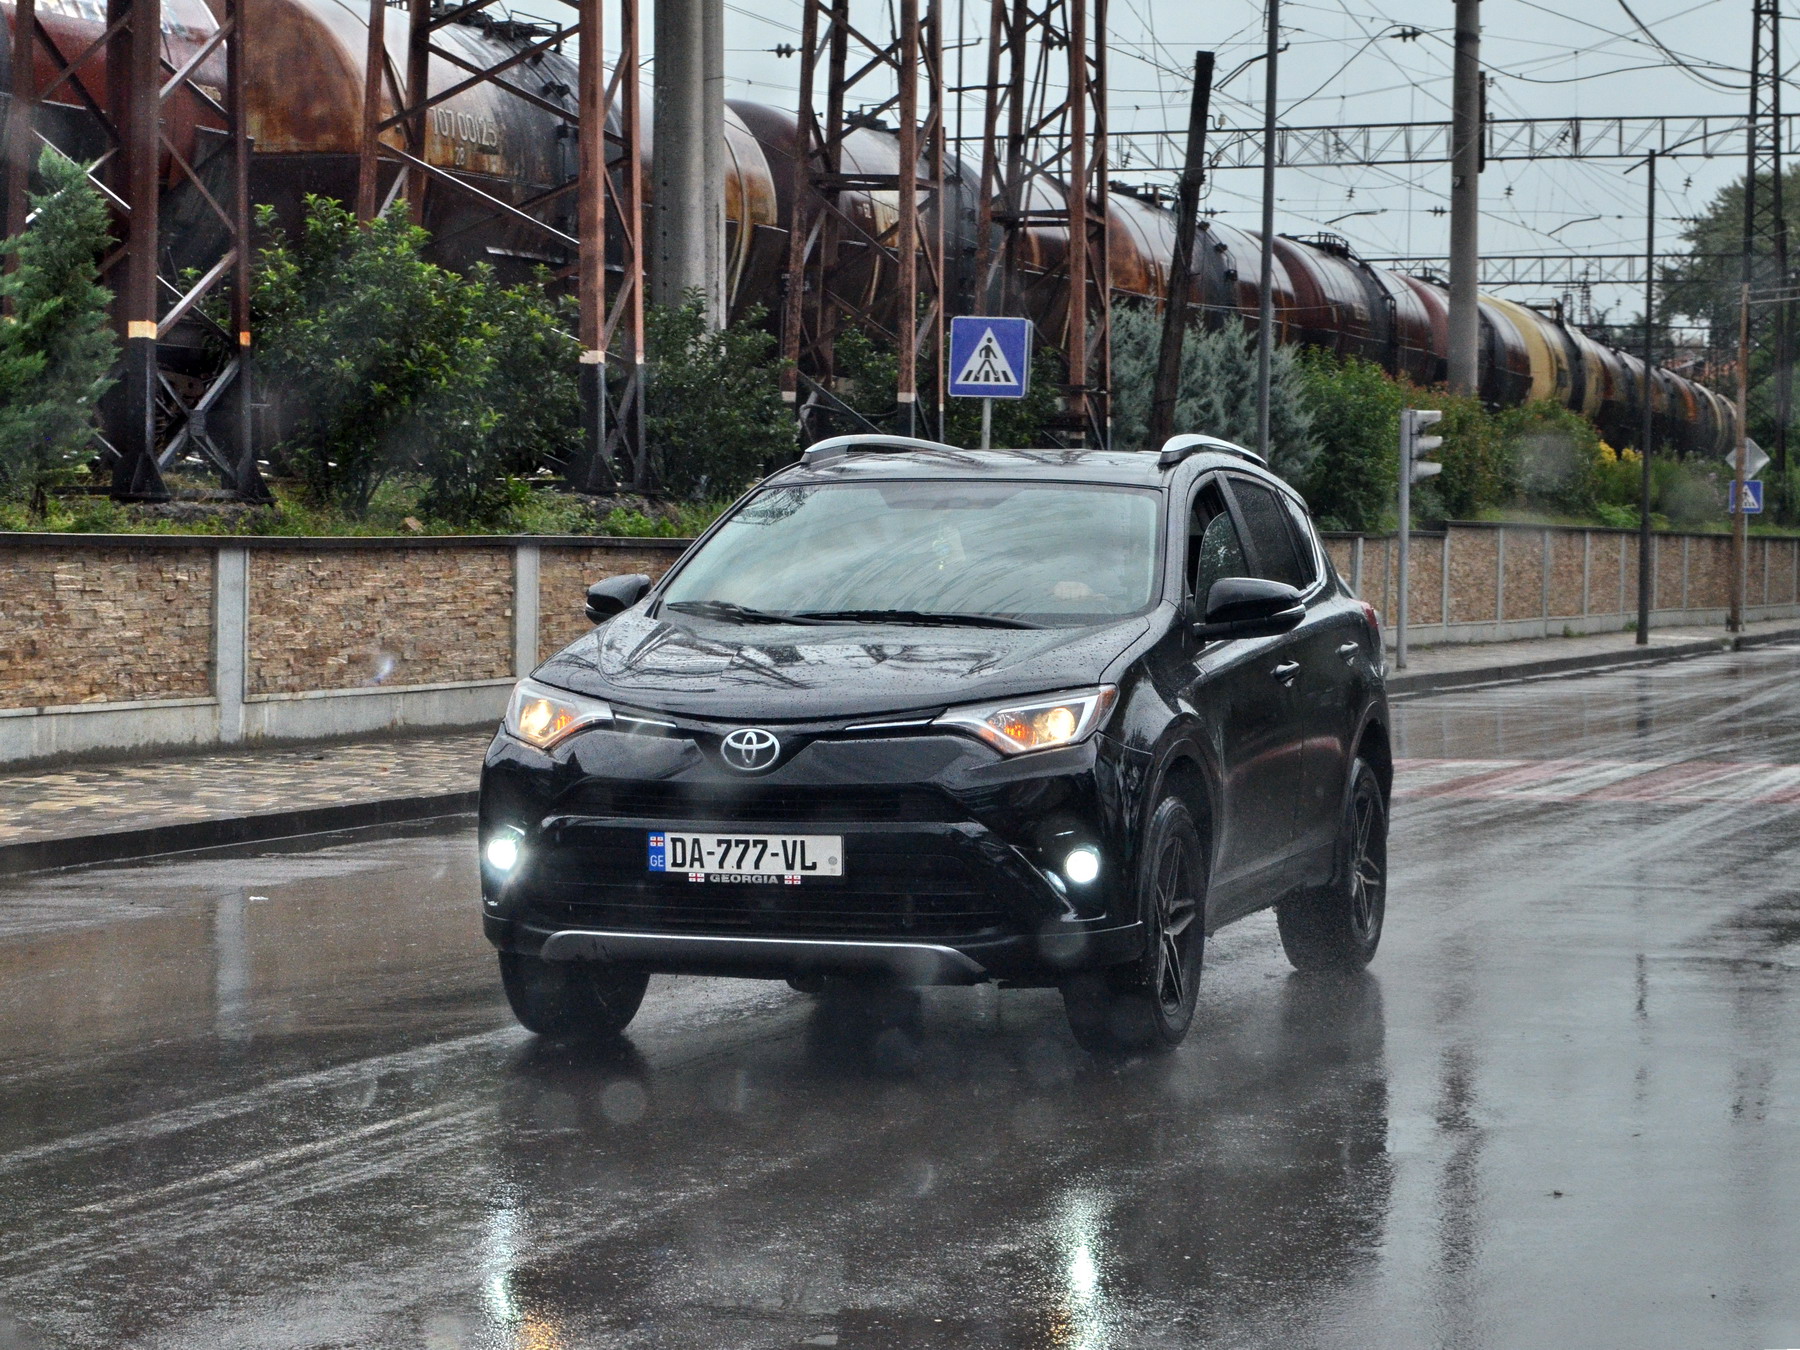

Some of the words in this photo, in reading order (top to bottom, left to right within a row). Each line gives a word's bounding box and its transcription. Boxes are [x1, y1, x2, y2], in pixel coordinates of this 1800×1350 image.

[650, 854, 665, 868] GE
[670, 837, 818, 871] DA-777-VL
[709, 873, 779, 884] GEORGIA
